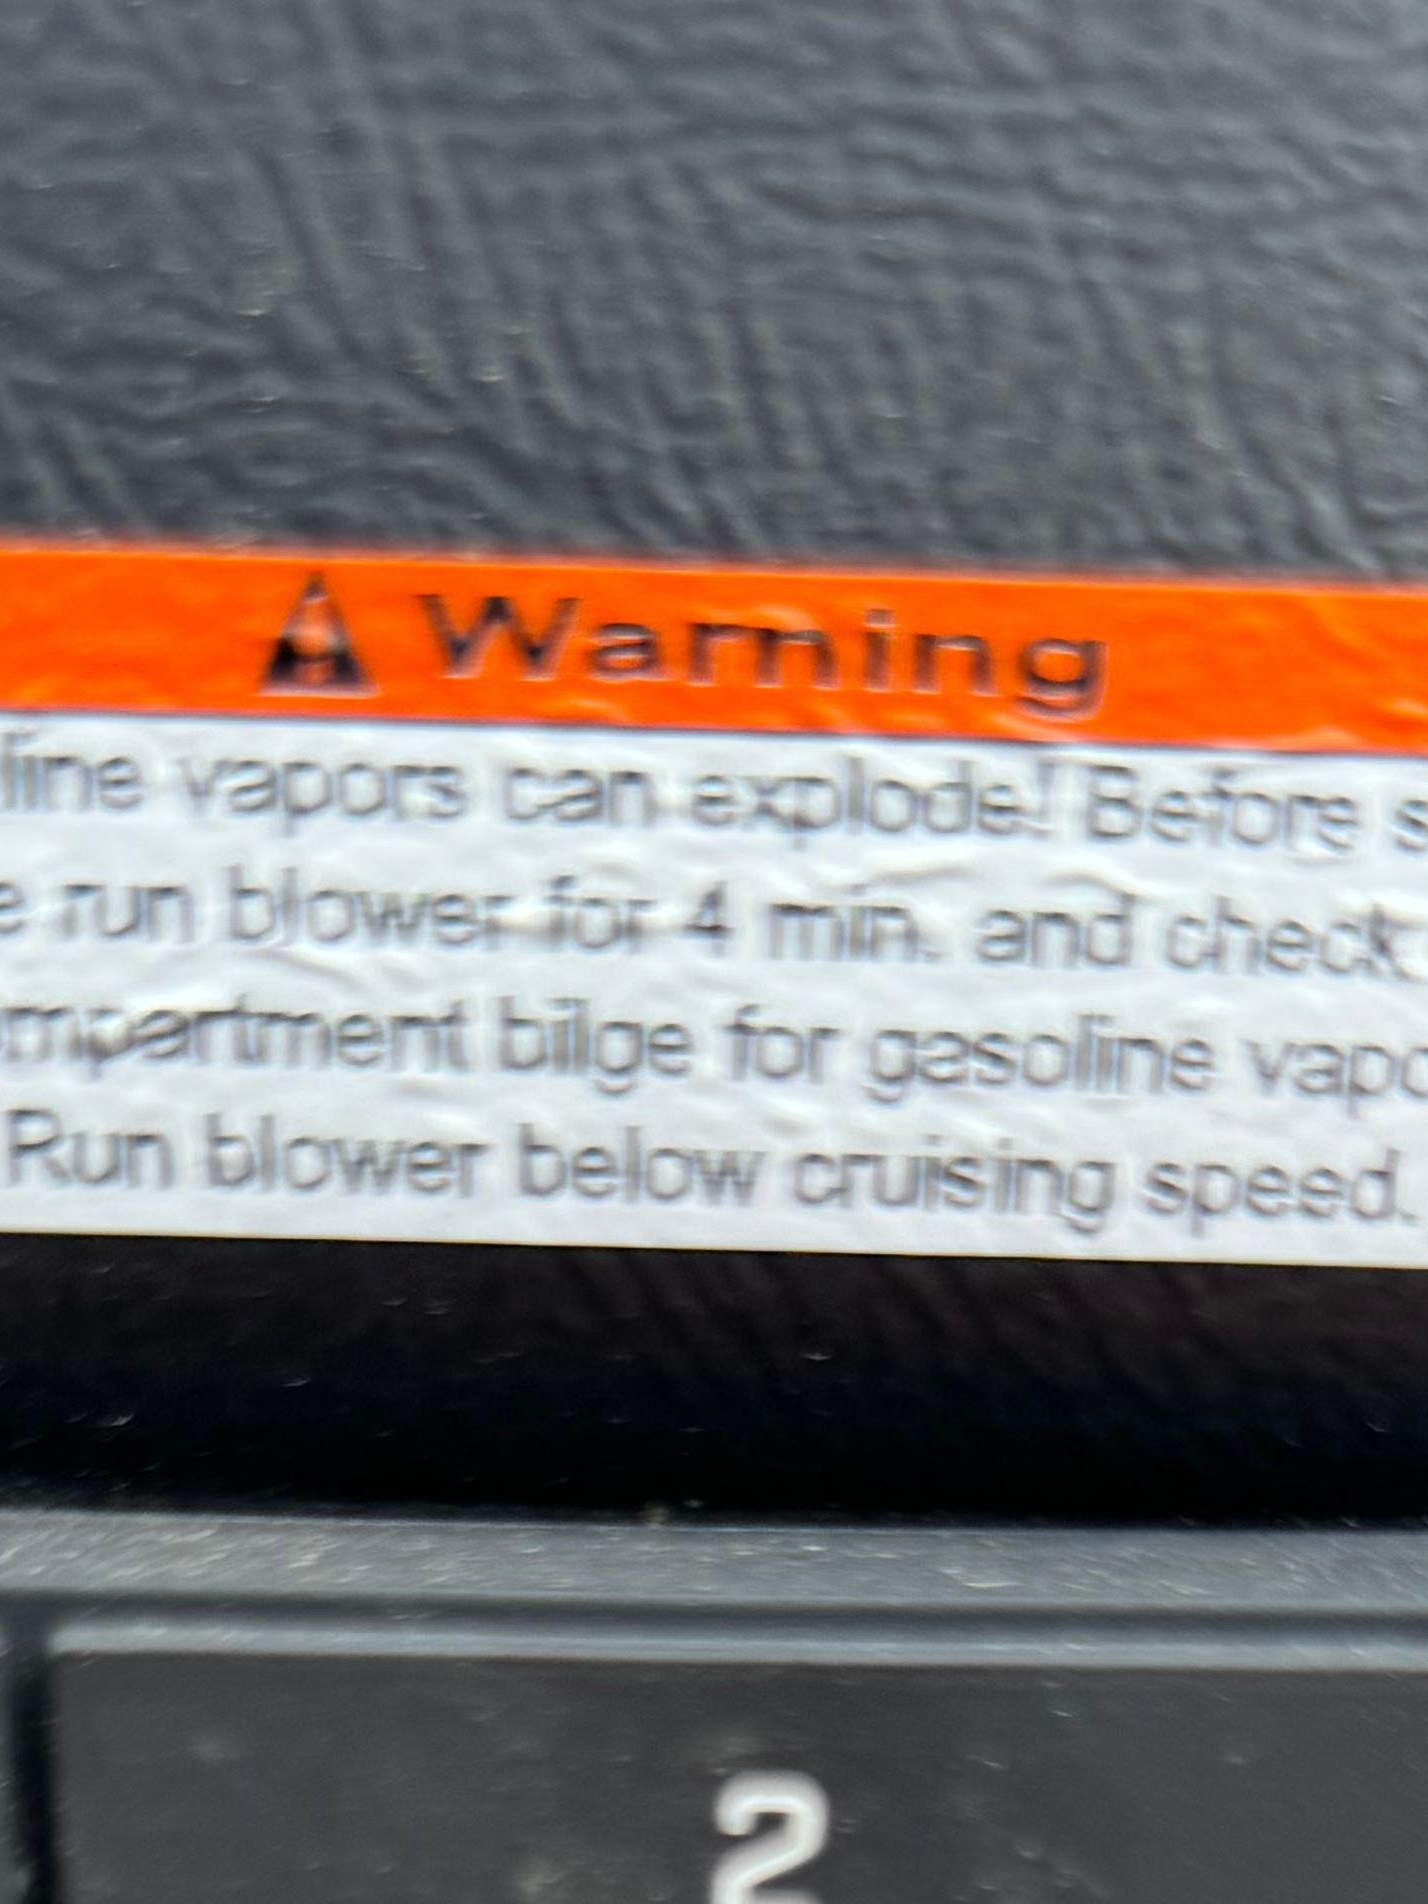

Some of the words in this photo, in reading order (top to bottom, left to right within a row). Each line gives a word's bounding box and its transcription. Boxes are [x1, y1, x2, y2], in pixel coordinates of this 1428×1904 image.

[415, 596, 1104, 716] Warning
[181, 758, 465, 831] vapors
[504, 762, 656, 826] can
[693, 758, 1055, 848] explode!
[1087, 765, 1359, 850] Before
[67, 887, 193, 942] run
[229, 865, 510, 951] blower
[544, 874, 656, 951] for
[684, 878, 729, 954] 4
[767, 885, 938, 964] min.
[978, 899, 1130, 971] and
[1167, 899, 1404, 979] check
[498, 997, 693, 1093] bilge
[727, 1007, 838, 1078] for
[870, 1014, 1213, 1101] gasoline
[7, 1108, 170, 1189] Run
[206, 1112, 488, 1198] blower
[518, 1123, 765, 1202] below
[795, 1132, 1113, 1235] cruising
[1143, 1151, 1416, 1232] speed.
